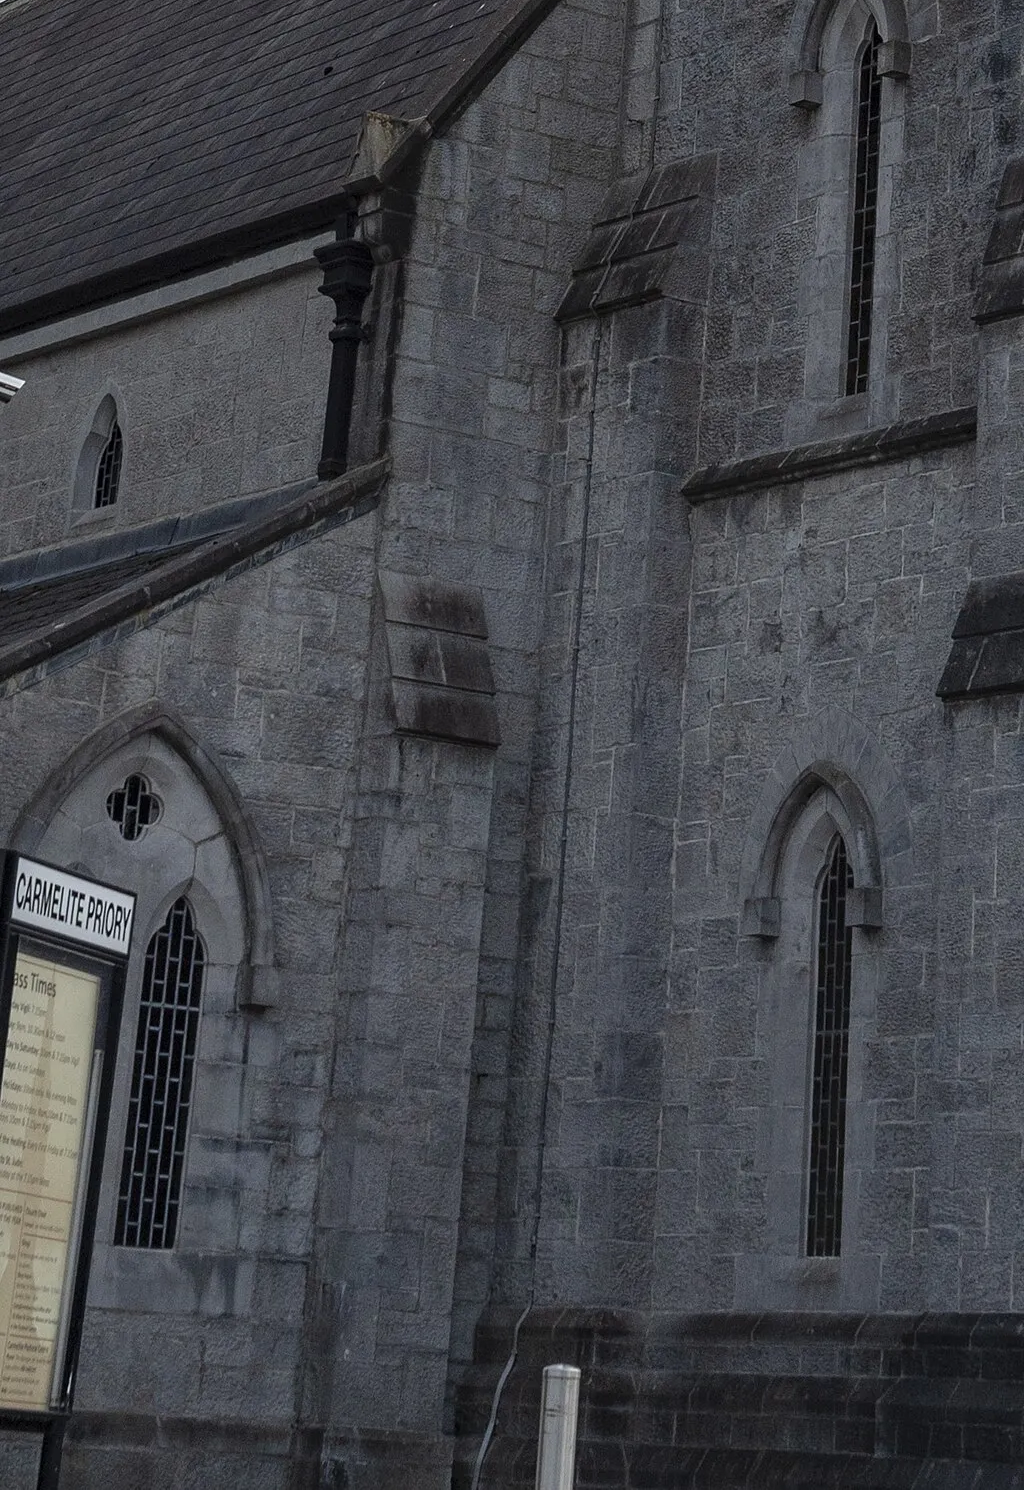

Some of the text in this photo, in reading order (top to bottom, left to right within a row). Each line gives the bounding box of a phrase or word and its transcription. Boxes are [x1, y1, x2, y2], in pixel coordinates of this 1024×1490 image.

[16, 872, 132, 942] CARMELITE PRIORY
[13, 972, 57, 998] ass Times
